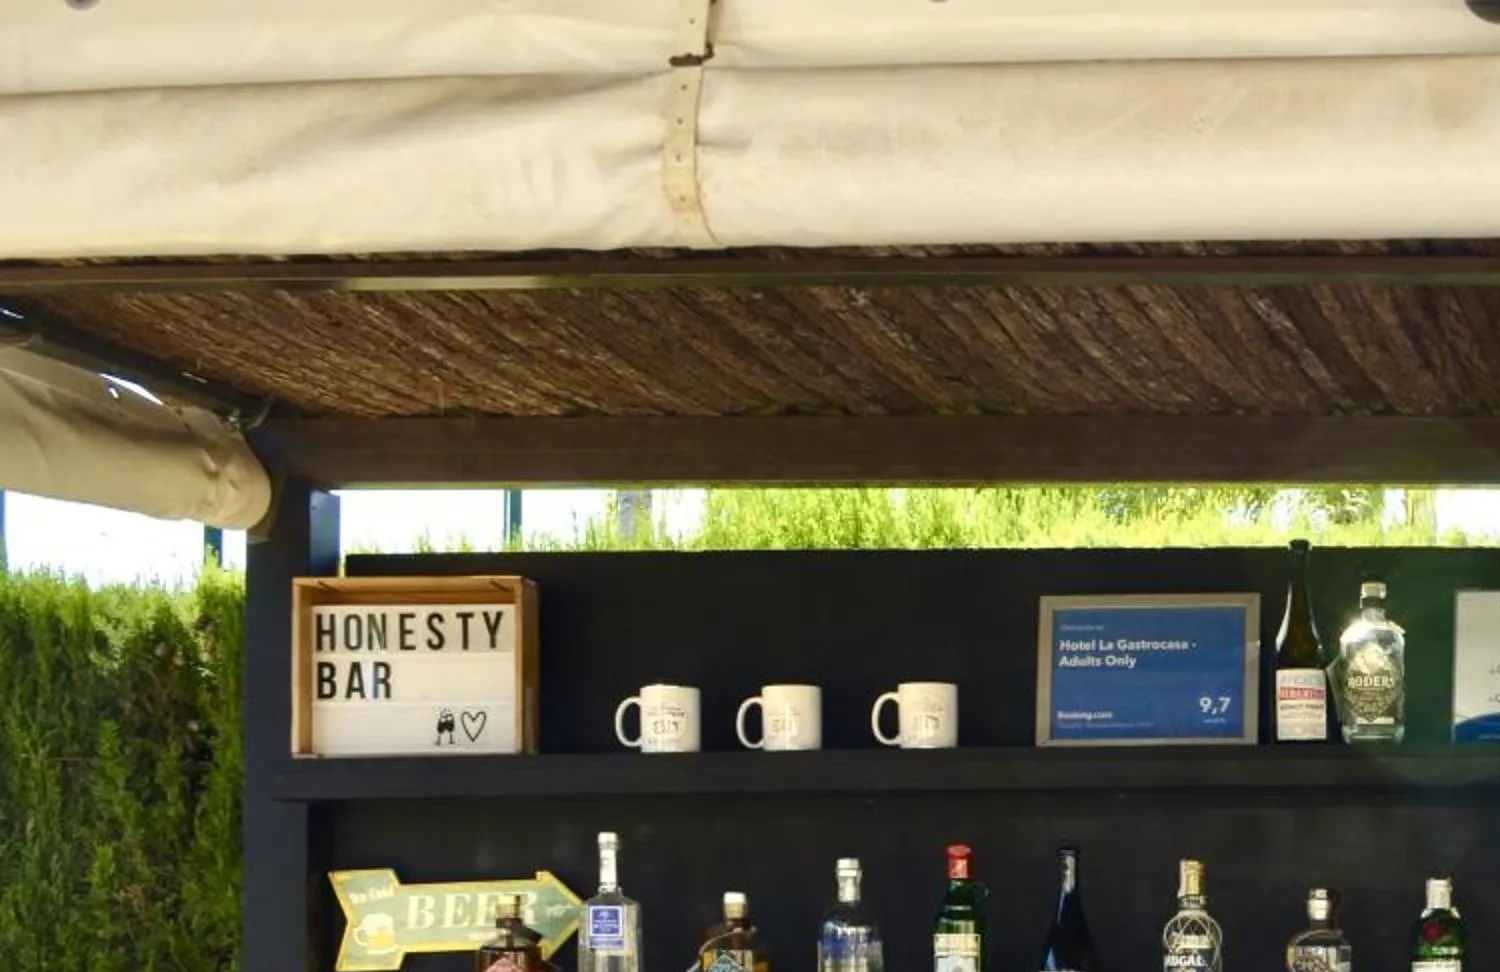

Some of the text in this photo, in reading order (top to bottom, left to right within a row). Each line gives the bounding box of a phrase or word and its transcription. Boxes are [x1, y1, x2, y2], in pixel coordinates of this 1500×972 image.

[315, 610, 503, 651] HONESTY
[1059, 638, 1096, 651] Hotel
[1099, 639, 1113, 651] La
[1116, 638, 1189, 651] Gastrocasa
[1059, 655, 1137, 669] Adults Only
[316, 661, 392, 700] BAR
[1199, 696, 1231, 716] 9,7
